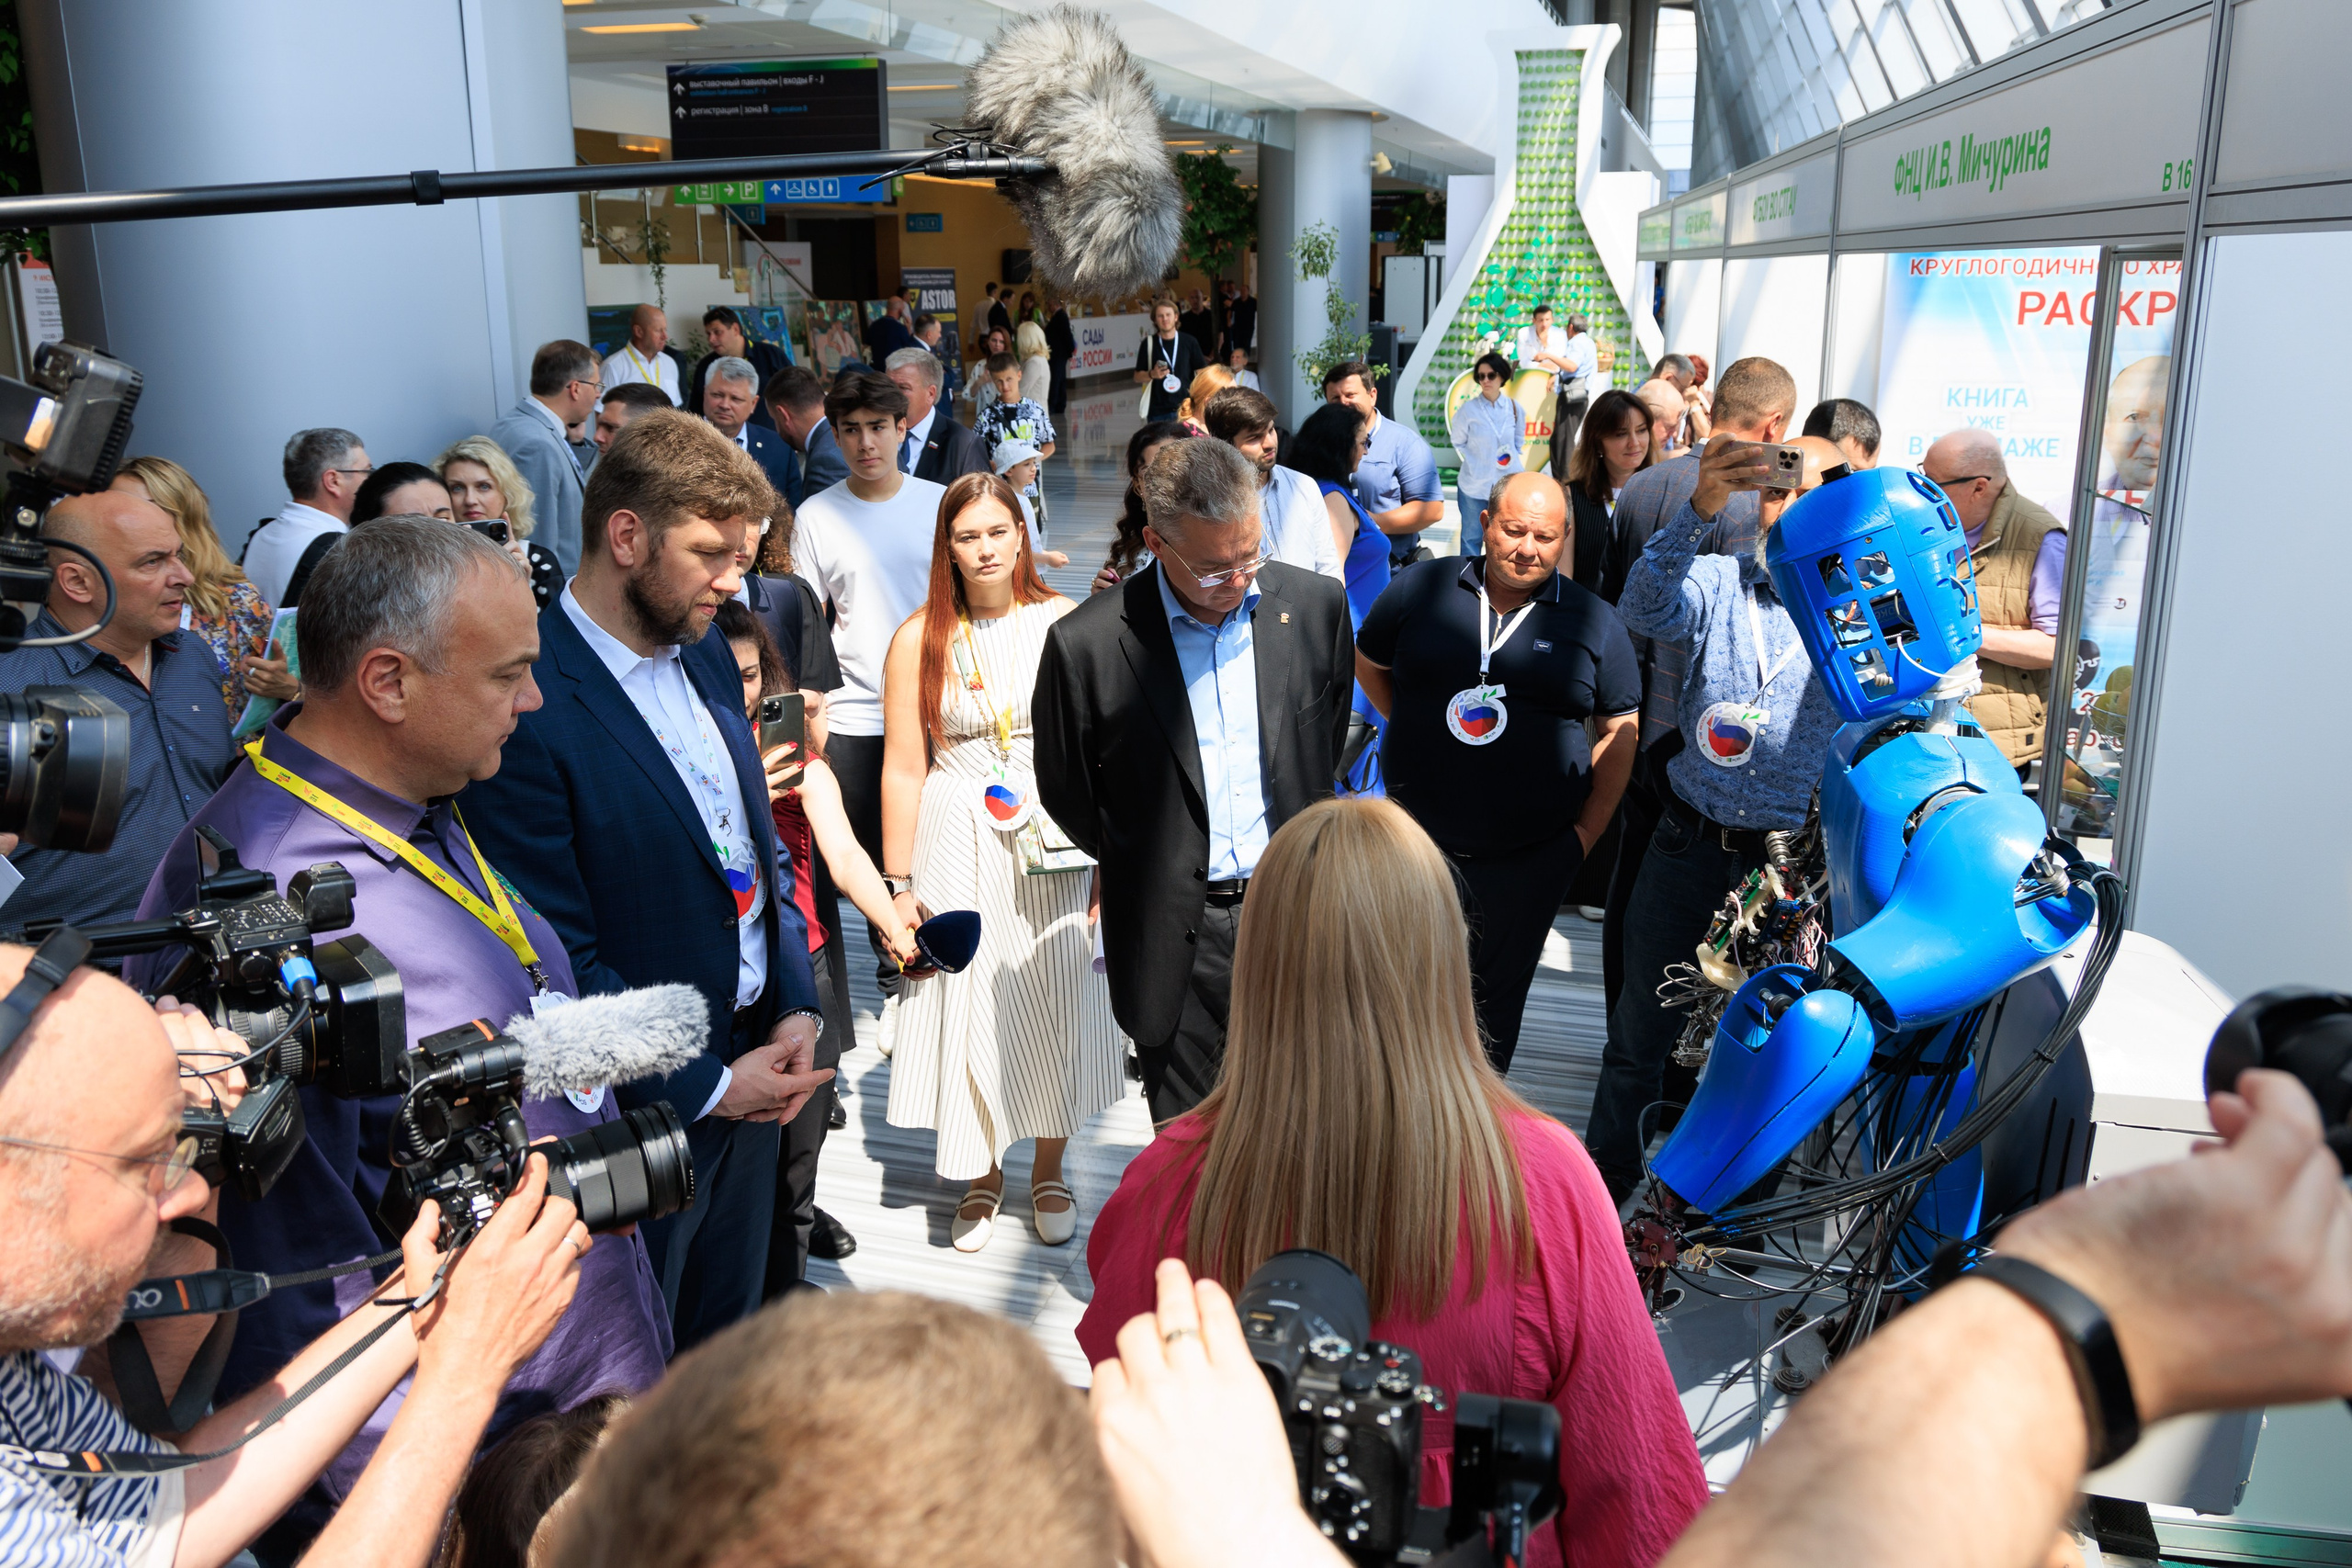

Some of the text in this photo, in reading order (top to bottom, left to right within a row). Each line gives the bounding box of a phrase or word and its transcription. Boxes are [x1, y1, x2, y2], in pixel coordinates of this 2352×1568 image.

[1894, 126, 2052, 202] ФНЦ И.В. Мичурина
[2177, 158, 2193, 190] 16
[922, 288, 956, 310] ASTOR
[1082, 327, 1104, 346] САДЫ
[1083, 348, 1113, 367] РОССИИ
[1947, 387, 2029, 408] КНИГА
[1967, 415, 2007, 430] УЖЕ
